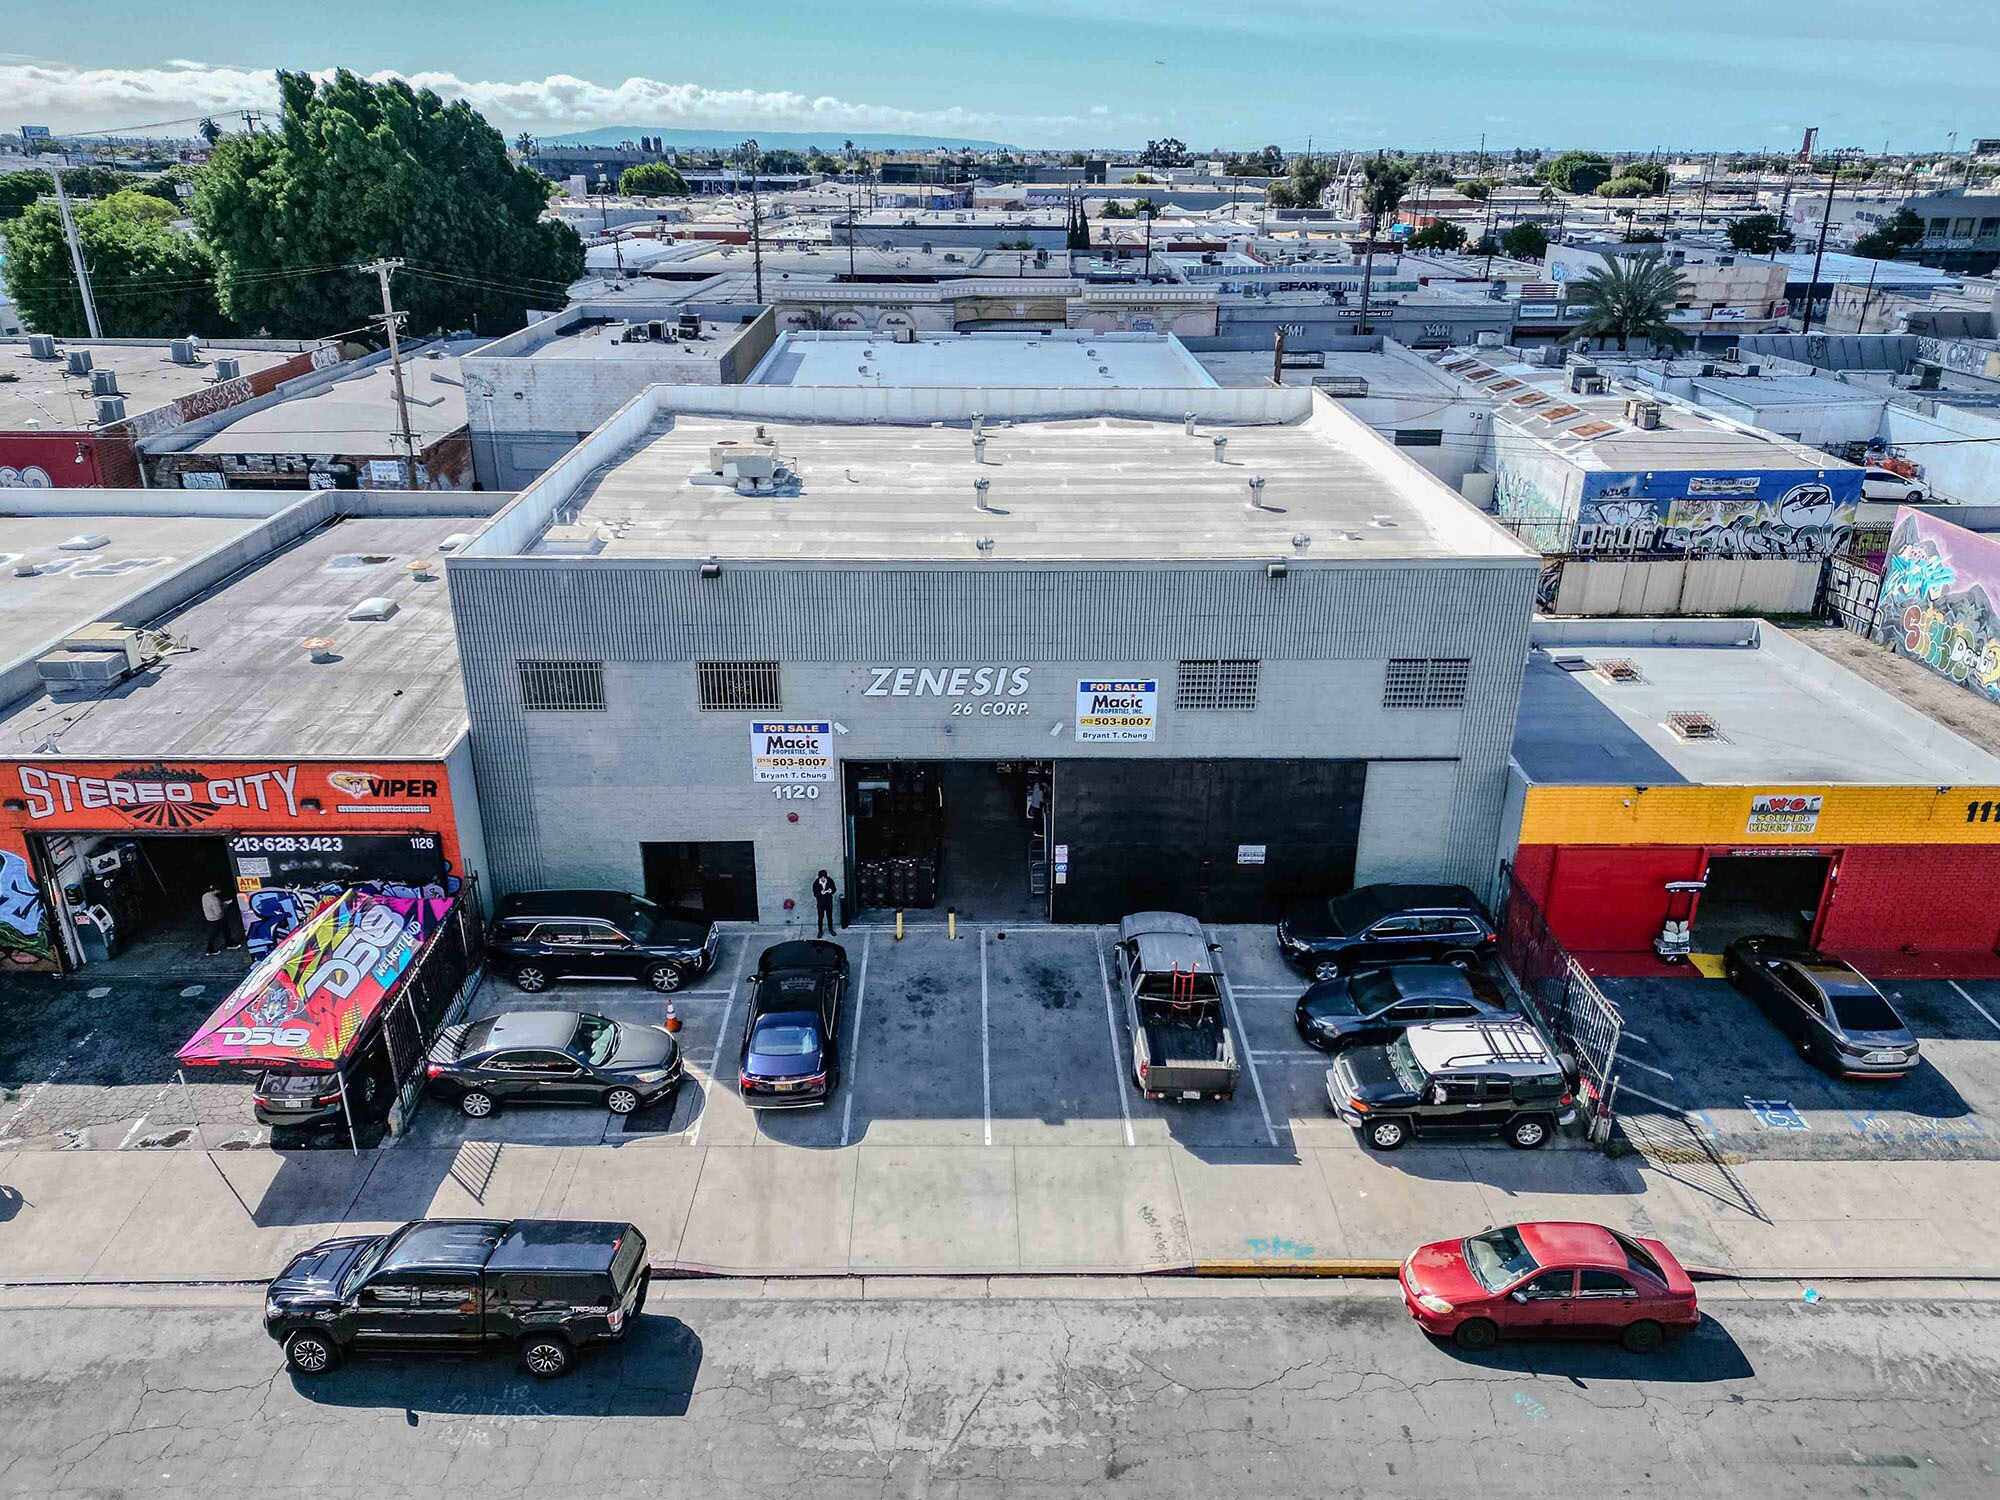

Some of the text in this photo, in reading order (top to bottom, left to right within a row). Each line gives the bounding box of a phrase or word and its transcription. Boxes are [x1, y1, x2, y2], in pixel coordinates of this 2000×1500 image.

[864, 666, 1032, 696] ZENESIS
[1090, 683, 1146, 691] FOR SALE
[952, 702, 1030, 716] 26 CORP.
[1094, 718, 1152, 726] 503-8007
[762, 724, 819, 732] FOR SALE
[1082, 732, 1110, 740] Bryant
[1122, 732, 1148, 740] Chung
[772, 758, 826, 766] 503-8007
[760, 772, 789, 780] Bryant
[800, 772, 826, 780] Chung
[17, 764, 298, 820] STEREO CITY
[367, 780, 438, 798] VIPER
[772, 785, 819, 800] 1120
[1756, 814, 1804, 822] SOUND
[1750, 822, 1814, 832] WINDOW TINT
[410, 838, 434, 850] 1126
[240, 878, 259, 886] ATM
[216, 1026, 311, 1048] DS18
